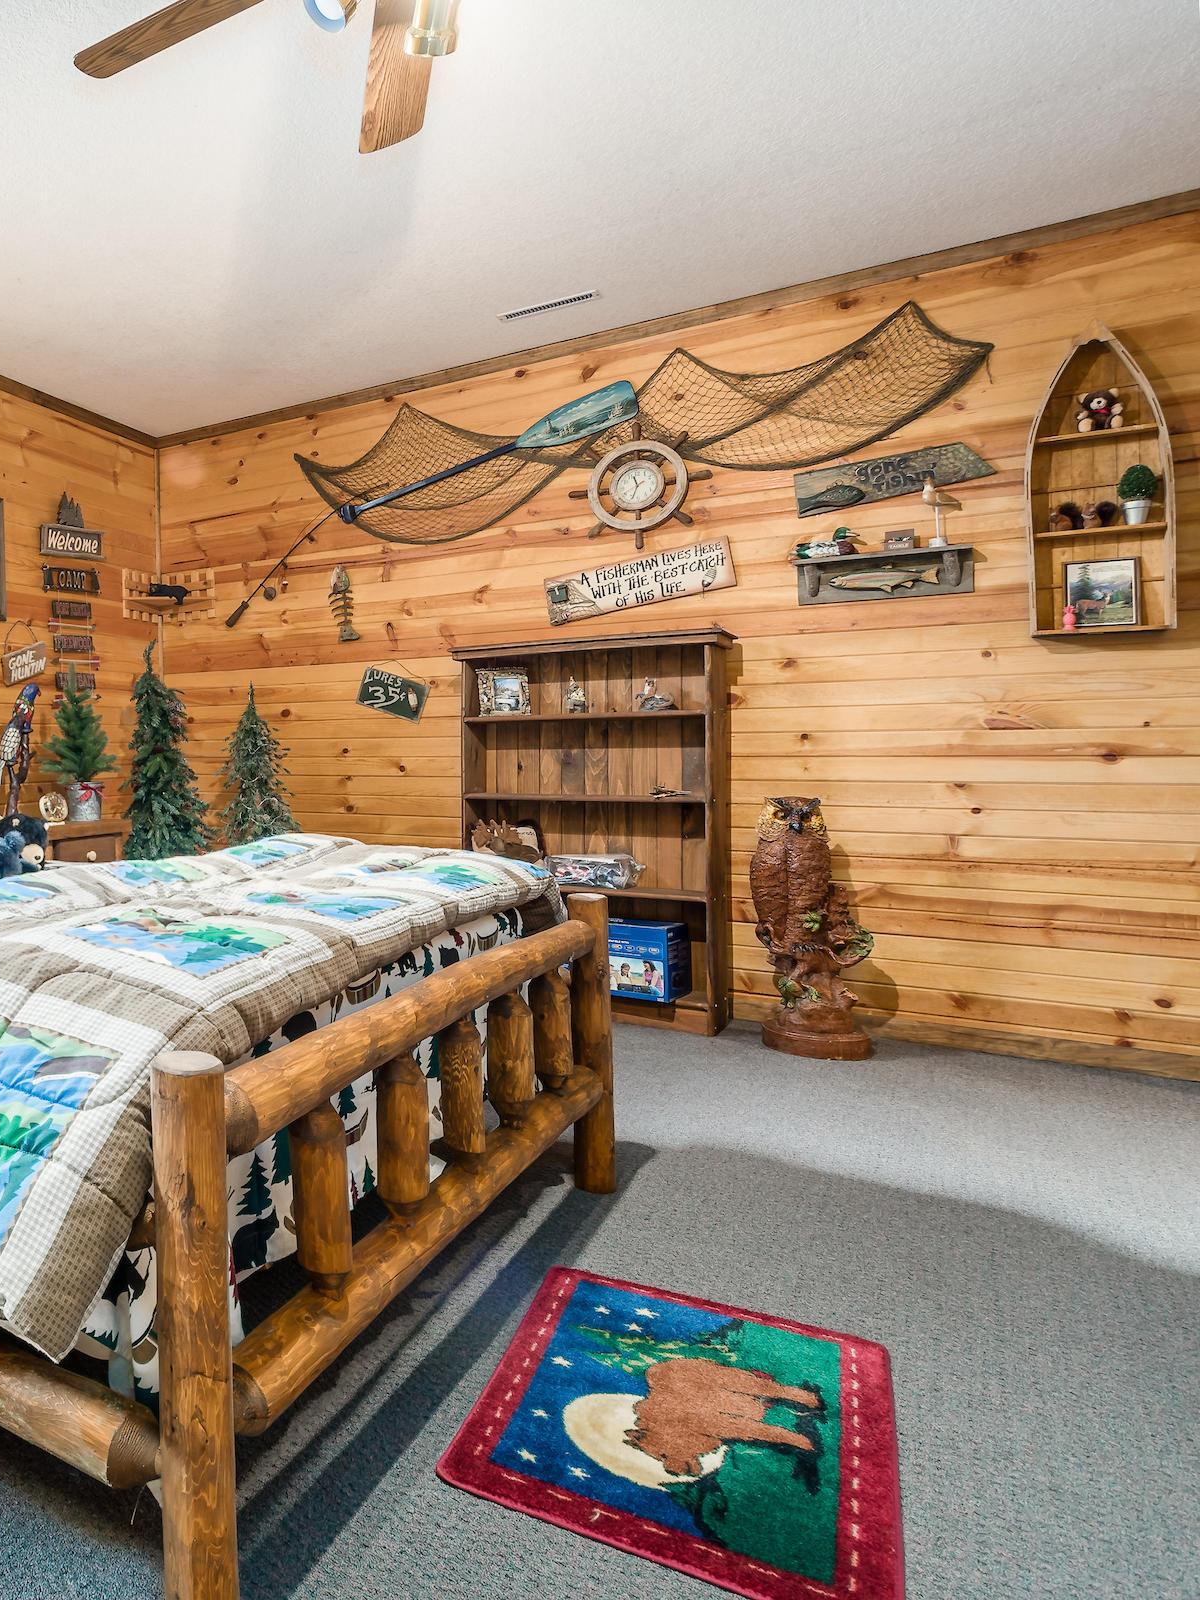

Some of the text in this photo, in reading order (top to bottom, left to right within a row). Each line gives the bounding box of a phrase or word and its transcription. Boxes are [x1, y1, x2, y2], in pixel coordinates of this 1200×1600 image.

[48, 529, 98, 553] Welcome
[581, 541, 723, 588] A FISHERMAN LIVES HERE
[58, 570, 86, 589] CAMP
[591, 582, 621, 599] WITH
[625, 575, 650, 590] THE
[615, 581, 686, 607] OF HIS LIFE
[9, 650, 36, 670] GONE
[11, 656, 46, 683] HUNTIN
[364, 669, 403, 687] LURES
